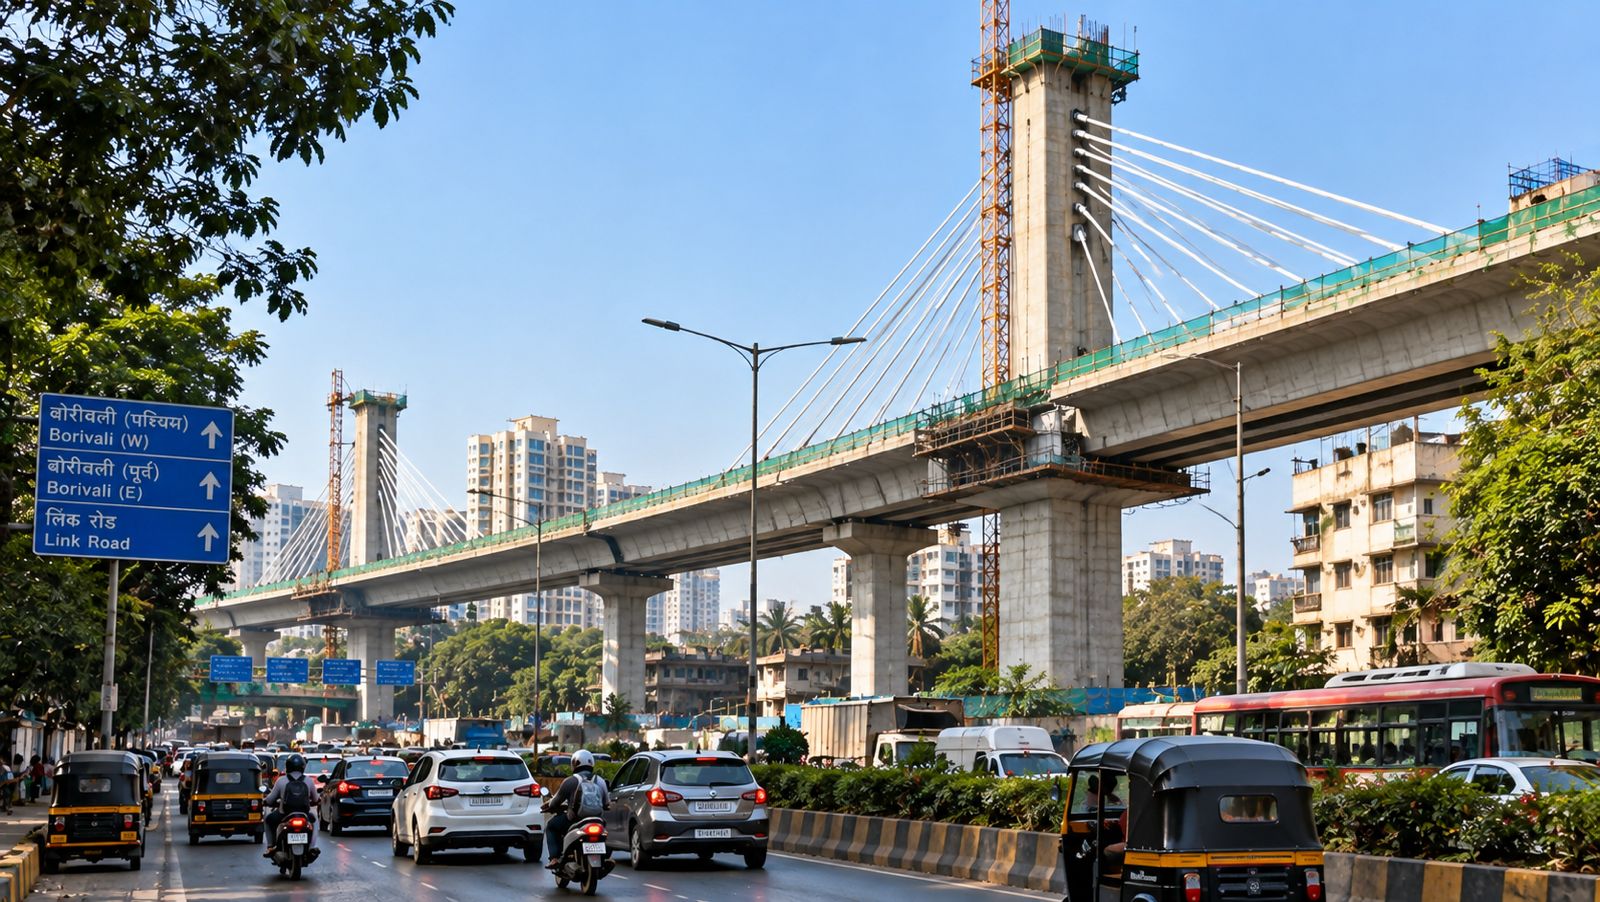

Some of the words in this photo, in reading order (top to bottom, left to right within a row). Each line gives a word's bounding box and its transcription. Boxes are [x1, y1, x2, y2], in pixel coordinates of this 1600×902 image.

[49, 402, 118, 425] बोरीवली
[49, 427, 113, 446] Borivali
[121, 433, 149, 450] (W)
[47, 455, 115, 477] बोरीवली
[122, 460, 159, 484] (पूर्व)
[47, 480, 111, 498] Borivali
[119, 485, 143, 502] (E)
[45, 506, 80, 527] लिंक
[88, 510, 117, 530] रोड
[44, 533, 80, 548] Link
[88, 535, 130, 550] Road
